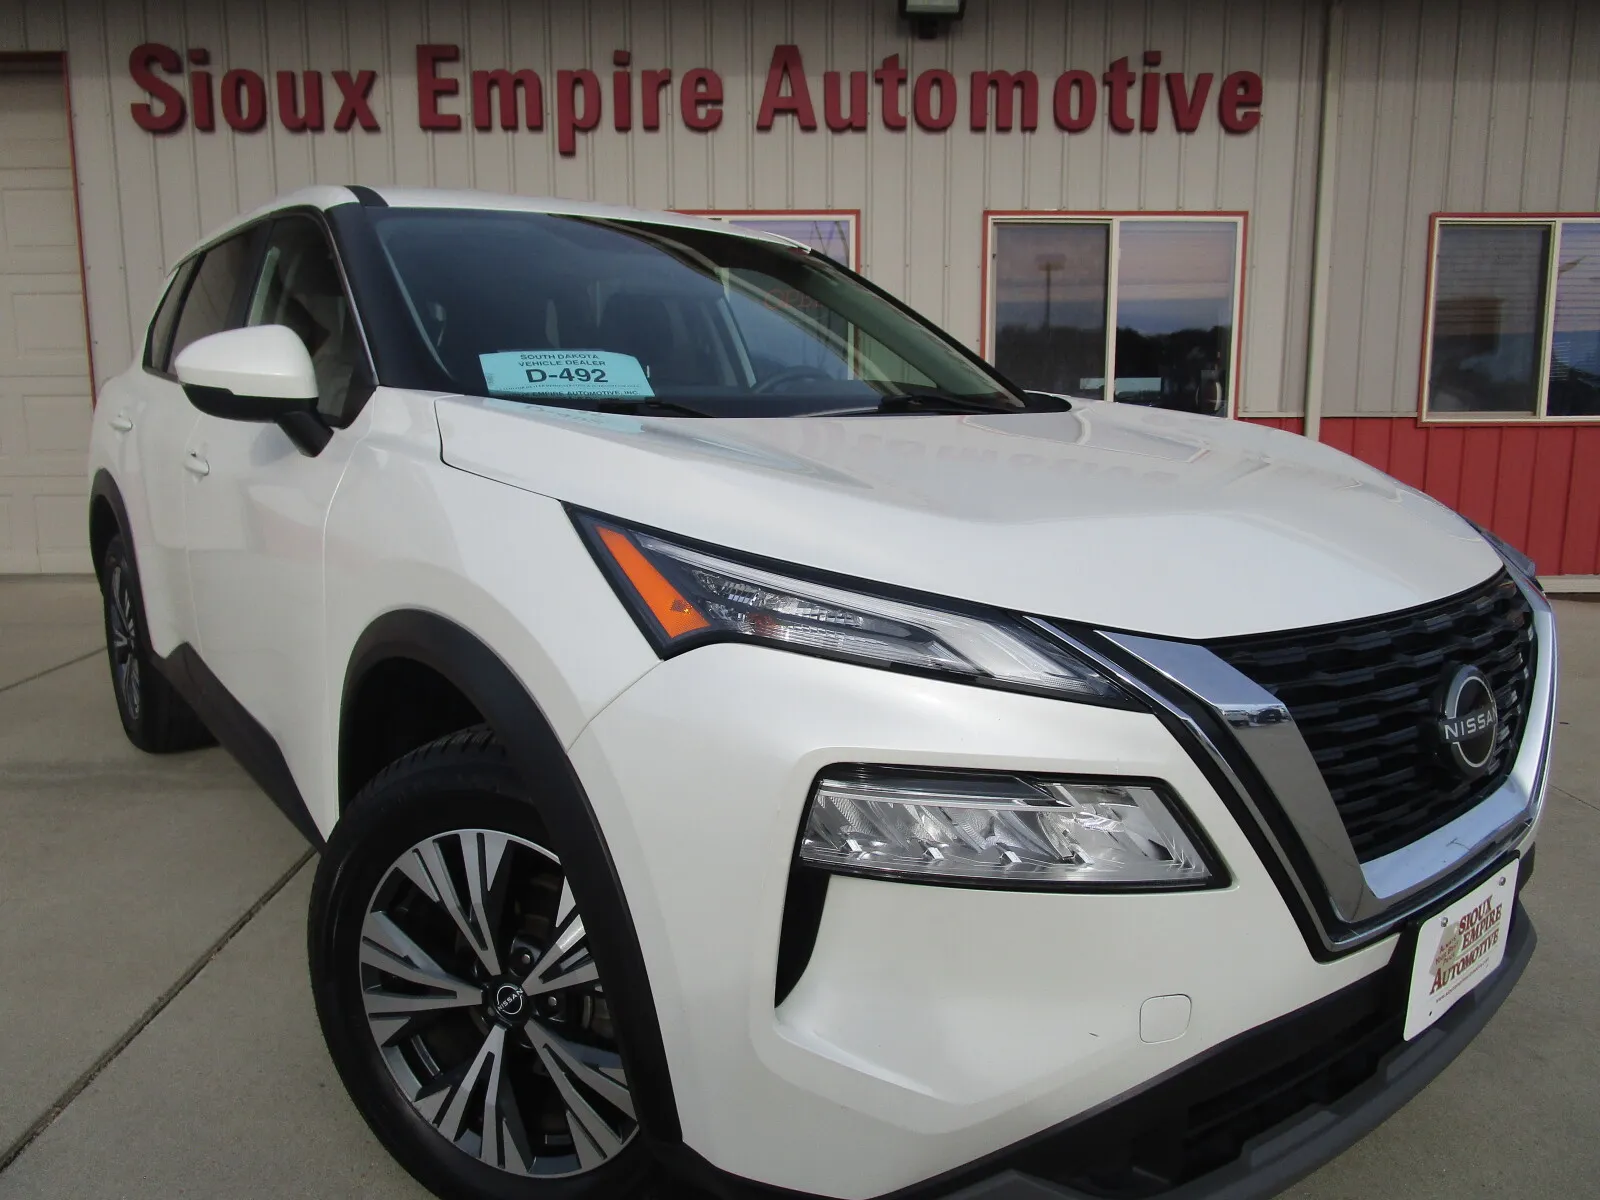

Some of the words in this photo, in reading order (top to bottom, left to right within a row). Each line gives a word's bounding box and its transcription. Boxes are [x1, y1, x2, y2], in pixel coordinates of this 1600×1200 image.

[128, 42, 382, 134] Sioux
[415, 43, 725, 156] Empire
[756, 43, 1264, 134] Automotive
[525, 367, 609, 383] D-492
[1444, 706, 1498, 740] NISSAN
[1458, 895, 1493, 936] SIOUX
[1461, 904, 1503, 951] EMPIRE
[1429, 928, 1500, 996] AUTOMOTIVE
[497, 988, 524, 1012] NISSAN
